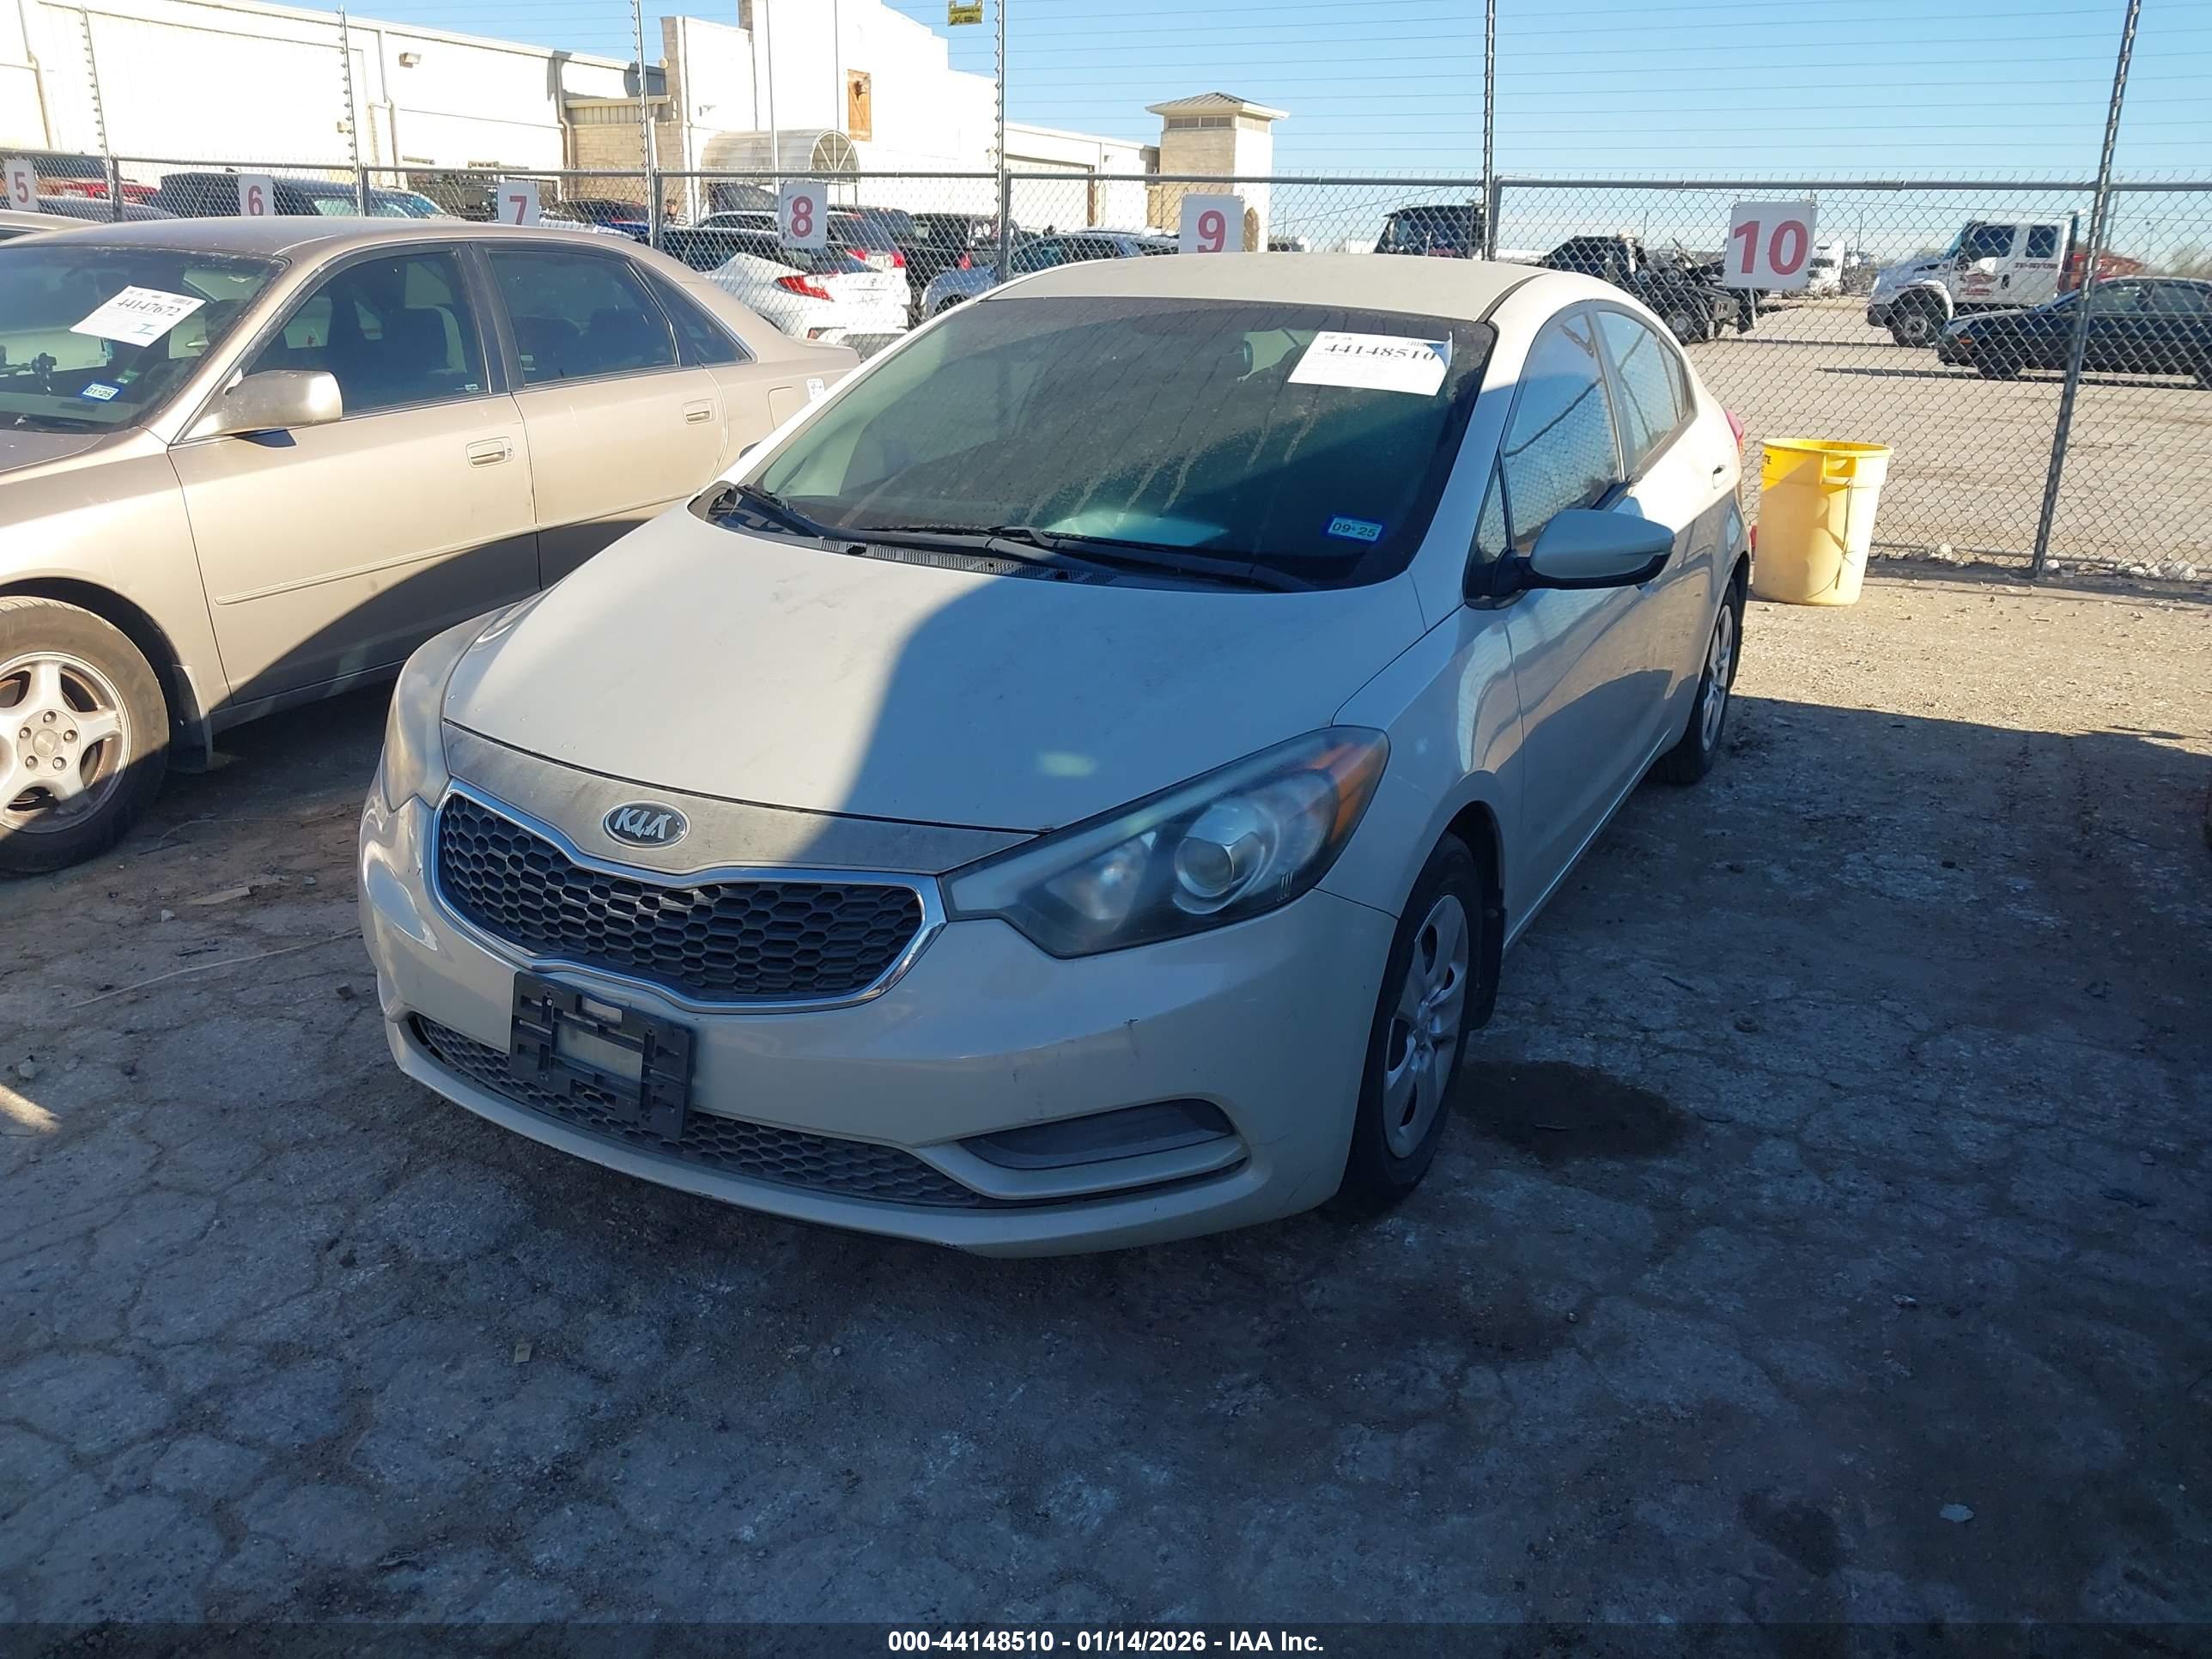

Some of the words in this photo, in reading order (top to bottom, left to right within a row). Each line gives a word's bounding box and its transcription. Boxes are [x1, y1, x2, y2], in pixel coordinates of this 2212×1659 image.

[14, 171, 29, 204] 5
[248, 185, 264, 216] 6
[508, 195, 527, 226] 7
[791, 196, 813, 238] 8
[1197, 210, 1226, 253] 9
[1734, 219, 1808, 276] 10
[117, 298, 182, 317] 44147672
[1324, 343, 1437, 362] 44148510
[614, 807, 672, 840] KIA
